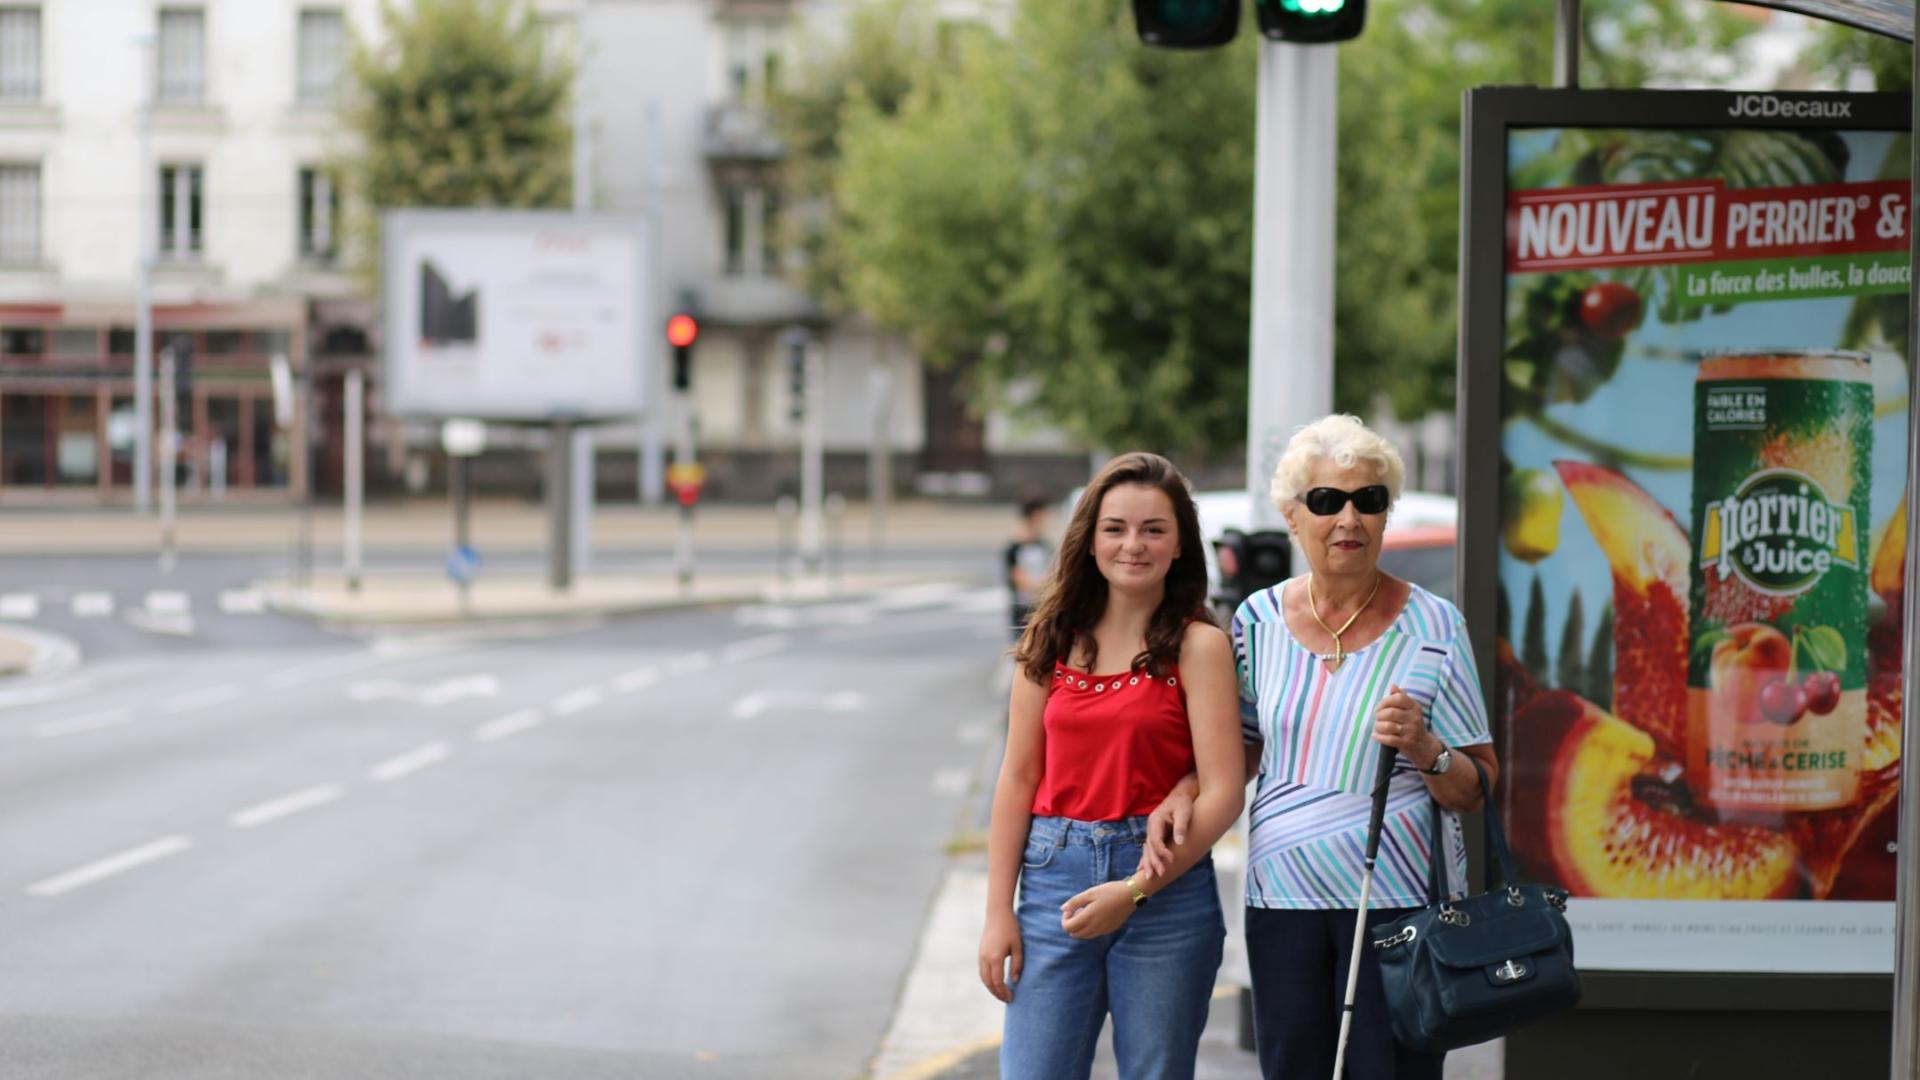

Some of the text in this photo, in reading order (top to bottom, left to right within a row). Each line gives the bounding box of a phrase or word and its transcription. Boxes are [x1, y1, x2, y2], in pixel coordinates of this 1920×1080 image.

[1728, 96, 1852, 119] JCDecaux
[1517, 195, 1716, 260] NOUVEAU
[1876, 193, 1906, 239] &
[1687, 273, 1706, 296] La
[1711, 270, 1752, 294] force
[1755, 268, 1785, 292] des
[1789, 264, 1844, 290] bulles,
[1849, 263, 1863, 286] la
[1718, 484, 1842, 582] perrier
[1752, 540, 1832, 573] Juice
[1782, 751, 1847, 771] CERISE
